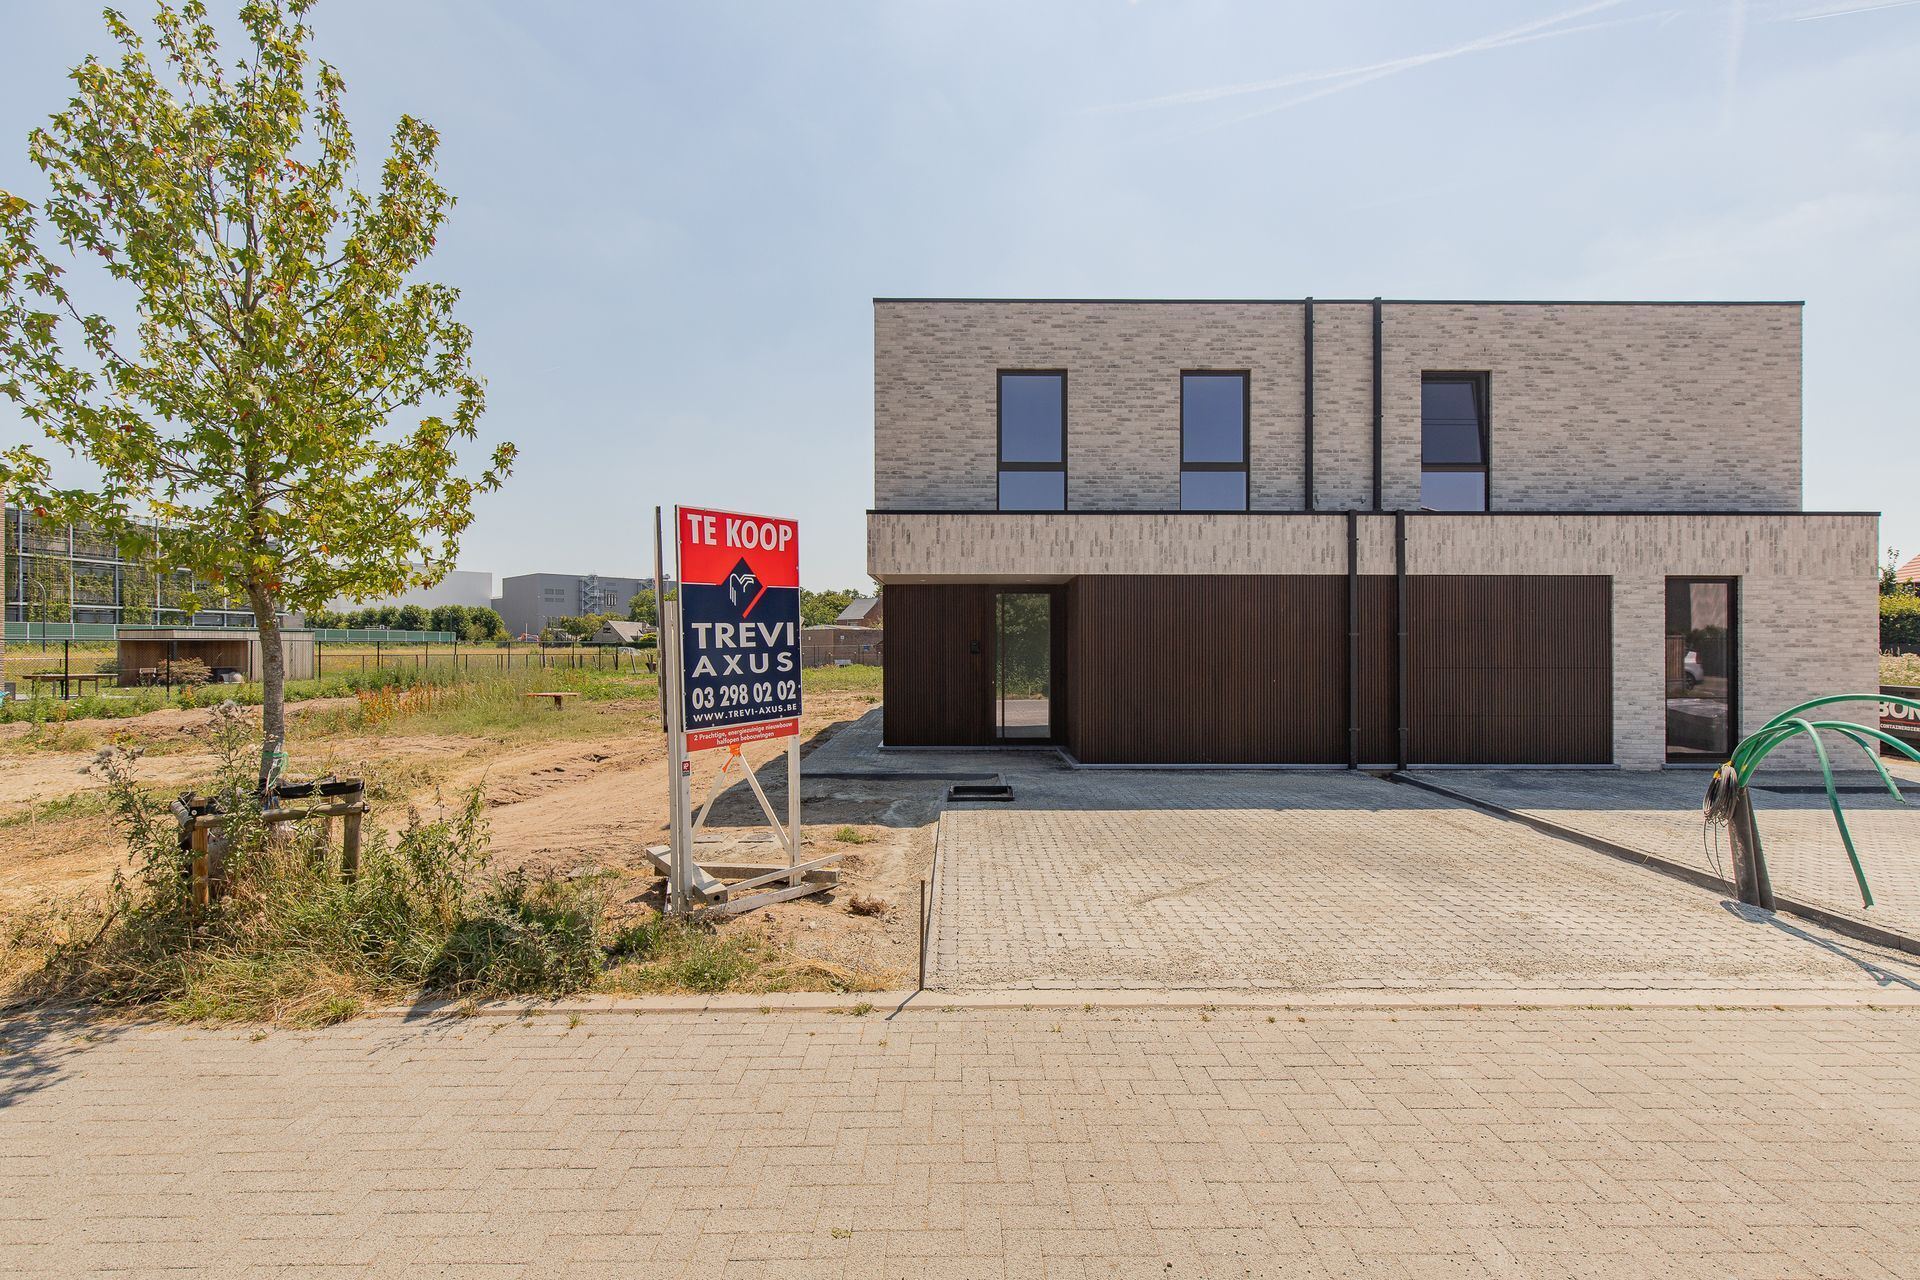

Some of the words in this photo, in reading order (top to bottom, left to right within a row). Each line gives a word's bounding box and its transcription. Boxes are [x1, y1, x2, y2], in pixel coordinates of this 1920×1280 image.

[687, 513, 717, 545] TE
[726, 518, 793, 552] KOOP
[691, 622, 795, 649] TREVI
[691, 651, 794, 678] AXUS
[692, 686, 715, 710] 03
[719, 683, 749, 707] 298
[753, 681, 773, 703] 02
[777, 679, 797, 701] 02
[692, 703, 797, 722] WWW.TREVI-AXUS.BE
[765, 722, 793, 730] nieuwbouw
